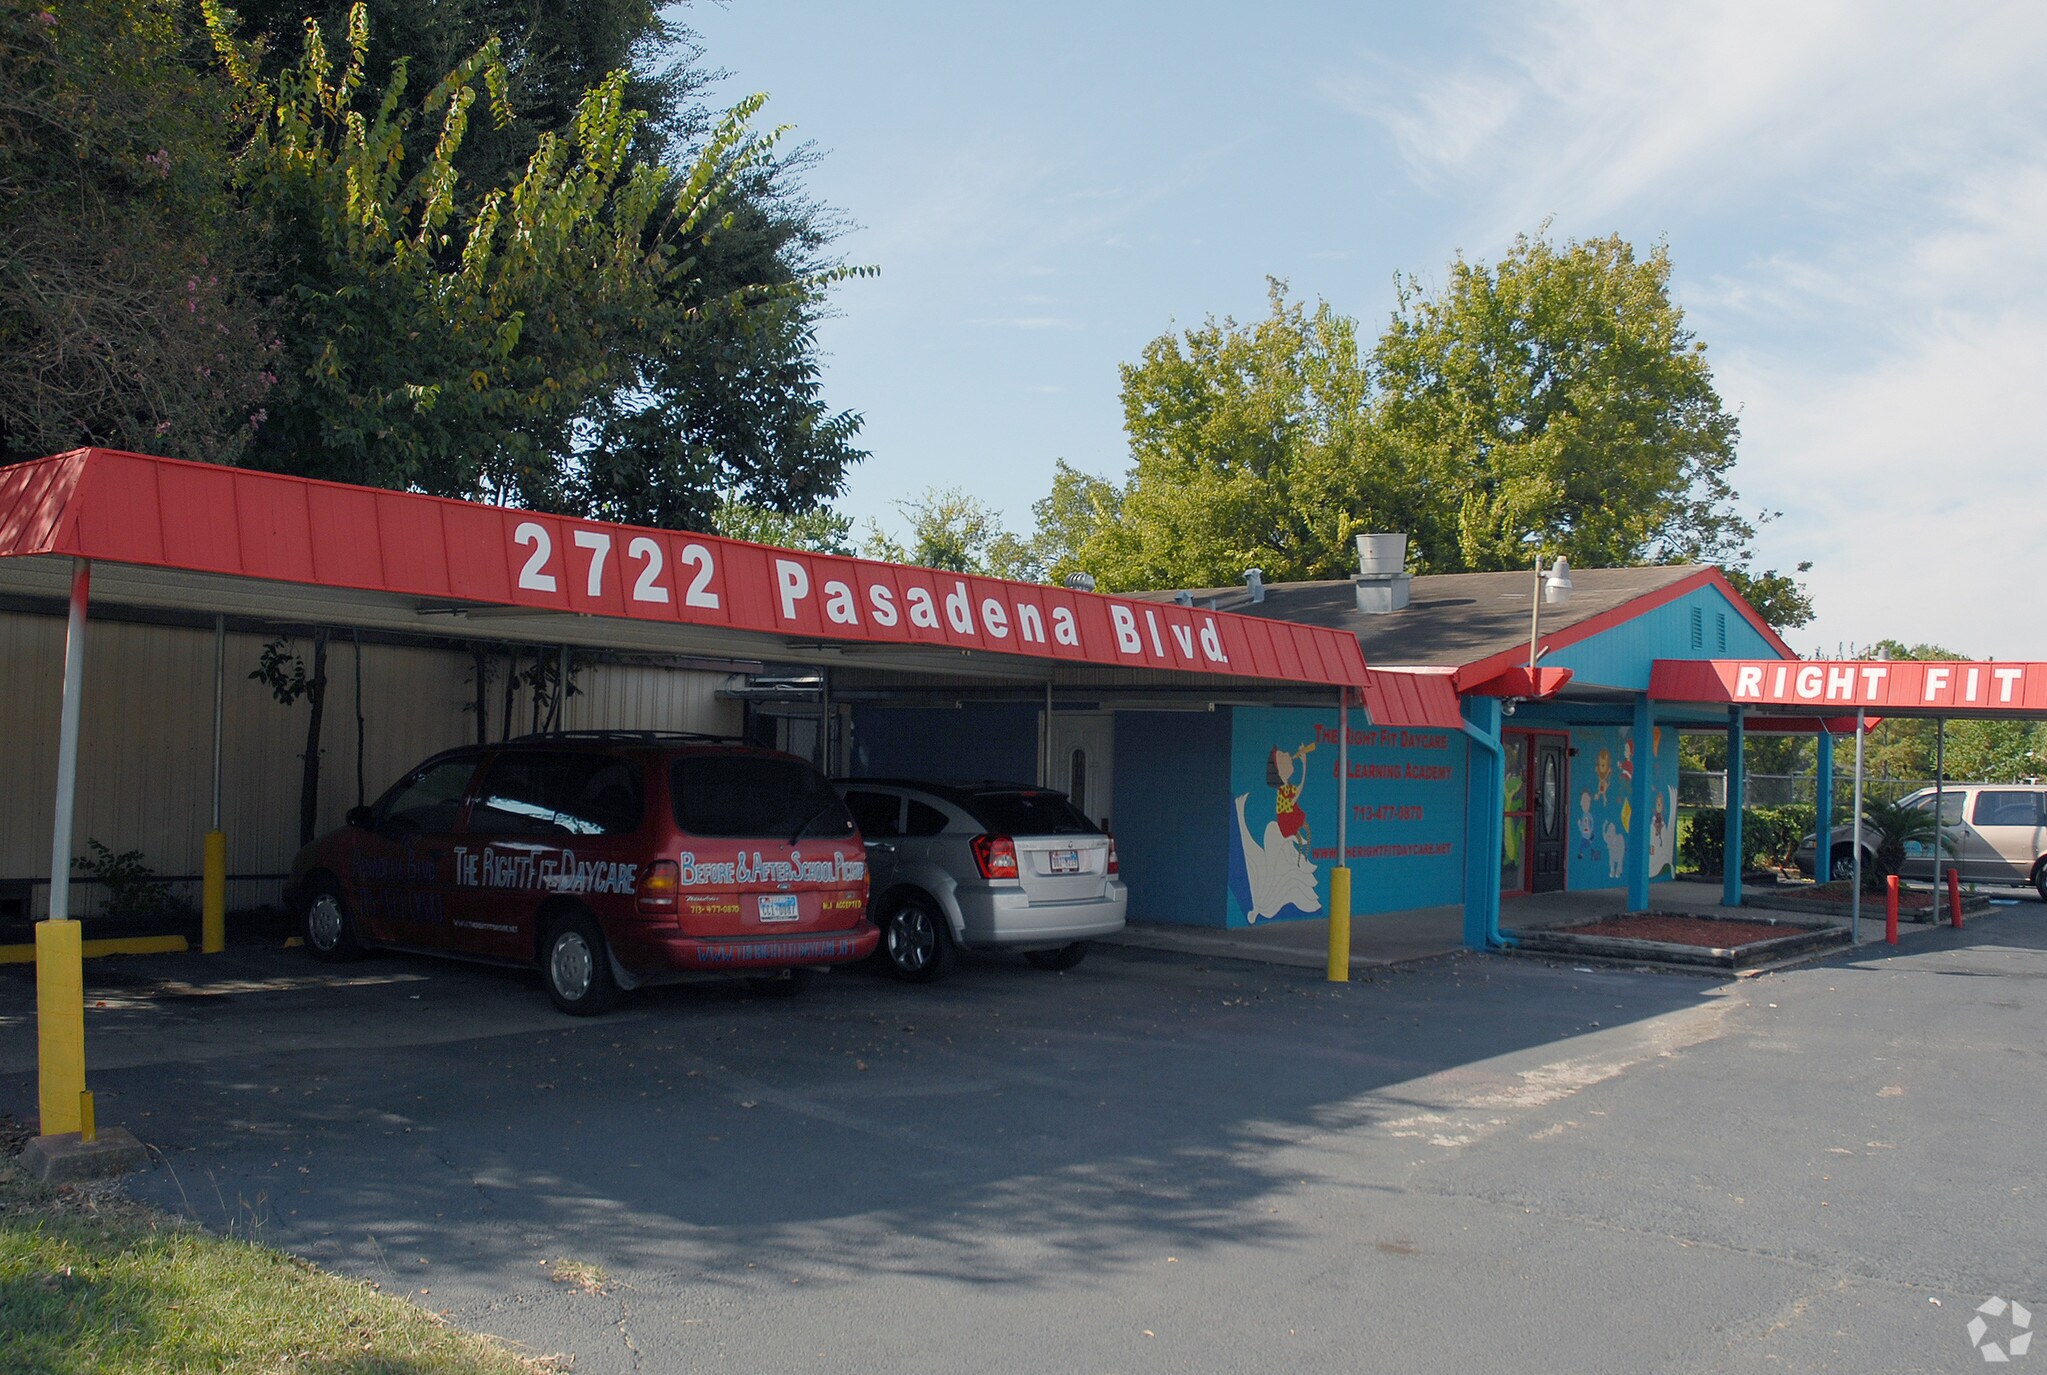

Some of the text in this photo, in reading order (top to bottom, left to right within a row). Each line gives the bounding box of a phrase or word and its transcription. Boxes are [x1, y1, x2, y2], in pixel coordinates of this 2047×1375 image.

[514, 522, 1228, 663] 2722 Pasadena Blvd.
[1737, 666, 2022, 702] RIGHT FIT
[1314, 724, 1339, 744] THE
[1380, 729, 1397, 748] FIT
[1400, 731, 1448, 750] DAYCARE
[1346, 760, 1402, 779] LEARNING
[1404, 762, 1453, 780] ACADEMY
[454, 846, 479, 887] THE
[680, 851, 735, 886] BEFORE
[736, 851, 751, 884] &
[750, 851, 793, 882] AFTER
[791, 851, 836, 883] SCHOOL
